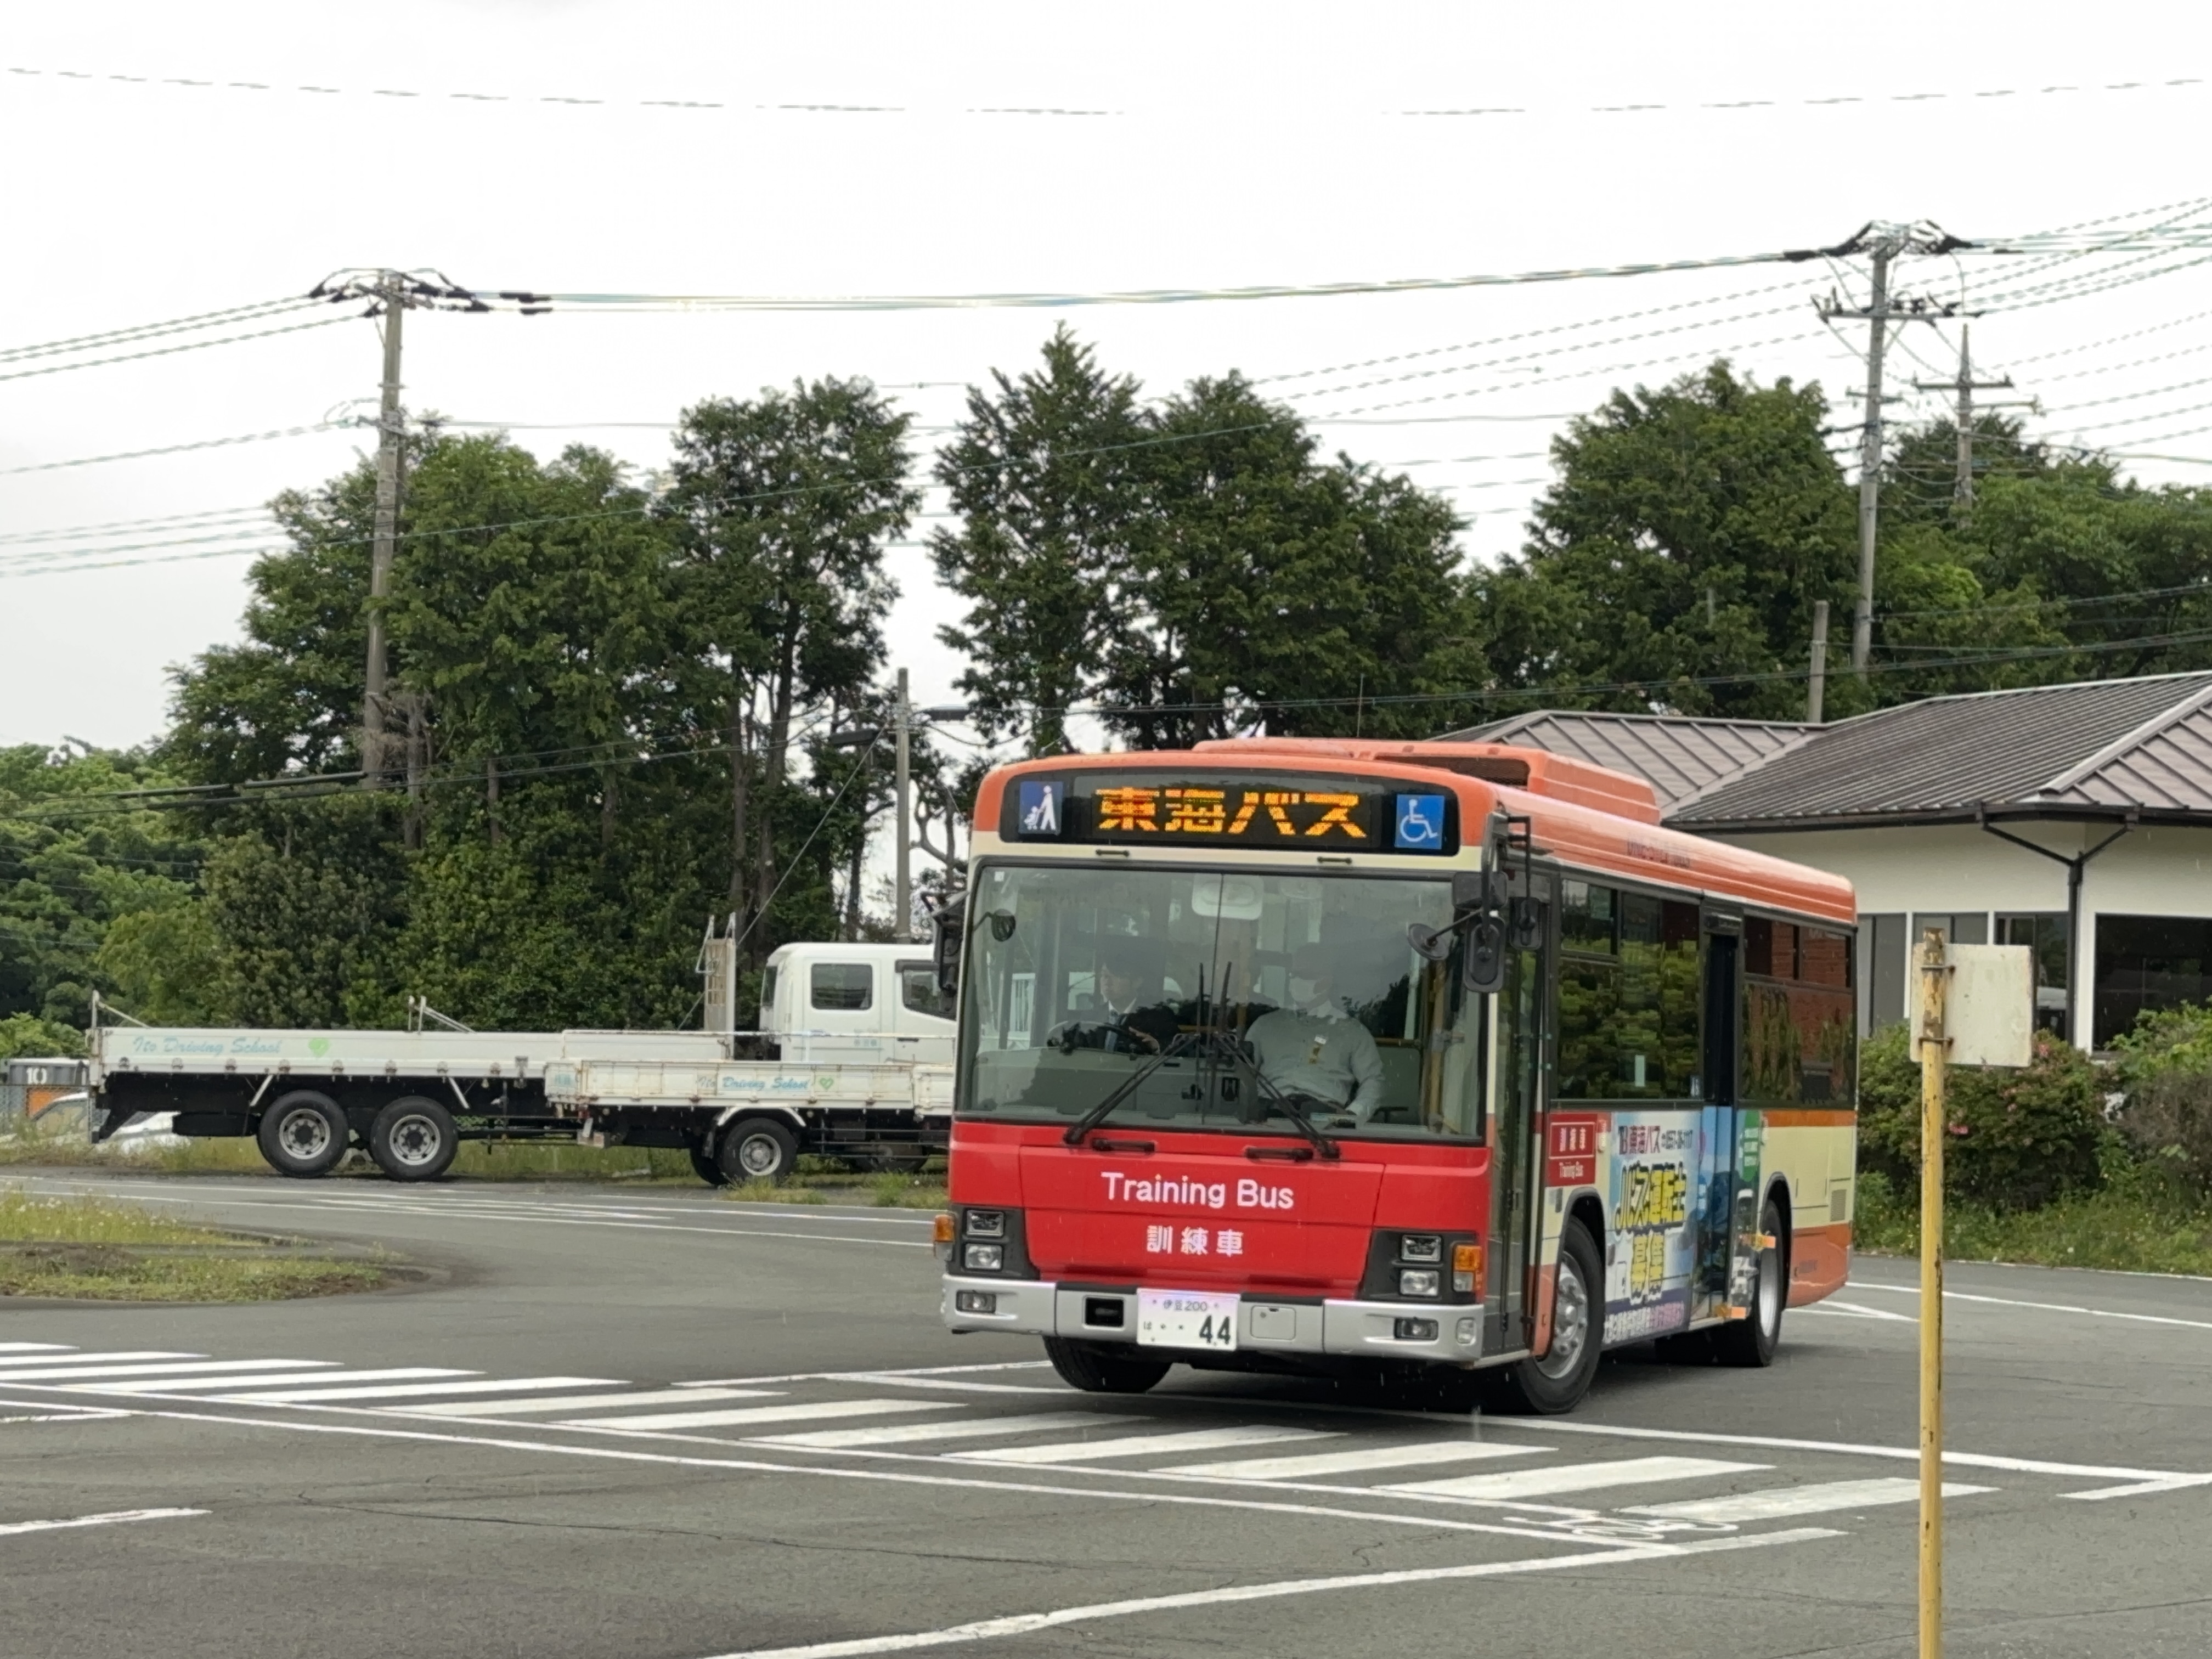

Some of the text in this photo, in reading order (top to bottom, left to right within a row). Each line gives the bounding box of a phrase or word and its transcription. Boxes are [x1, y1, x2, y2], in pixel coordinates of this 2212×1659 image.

[1095, 786, 1367, 838] 東海バス
[163, 1036, 224, 1056] Driving
[230, 1036, 283, 1053] School
[27, 1067, 47, 1085] 10
[723, 1076, 765, 1091] Driving
[771, 1075, 810, 1090] School
[1101, 1171, 1294, 1209] Training Bus
[1147, 1224, 1244, 1257] 訓練車
[1199, 1314, 1231, 1345] 44
